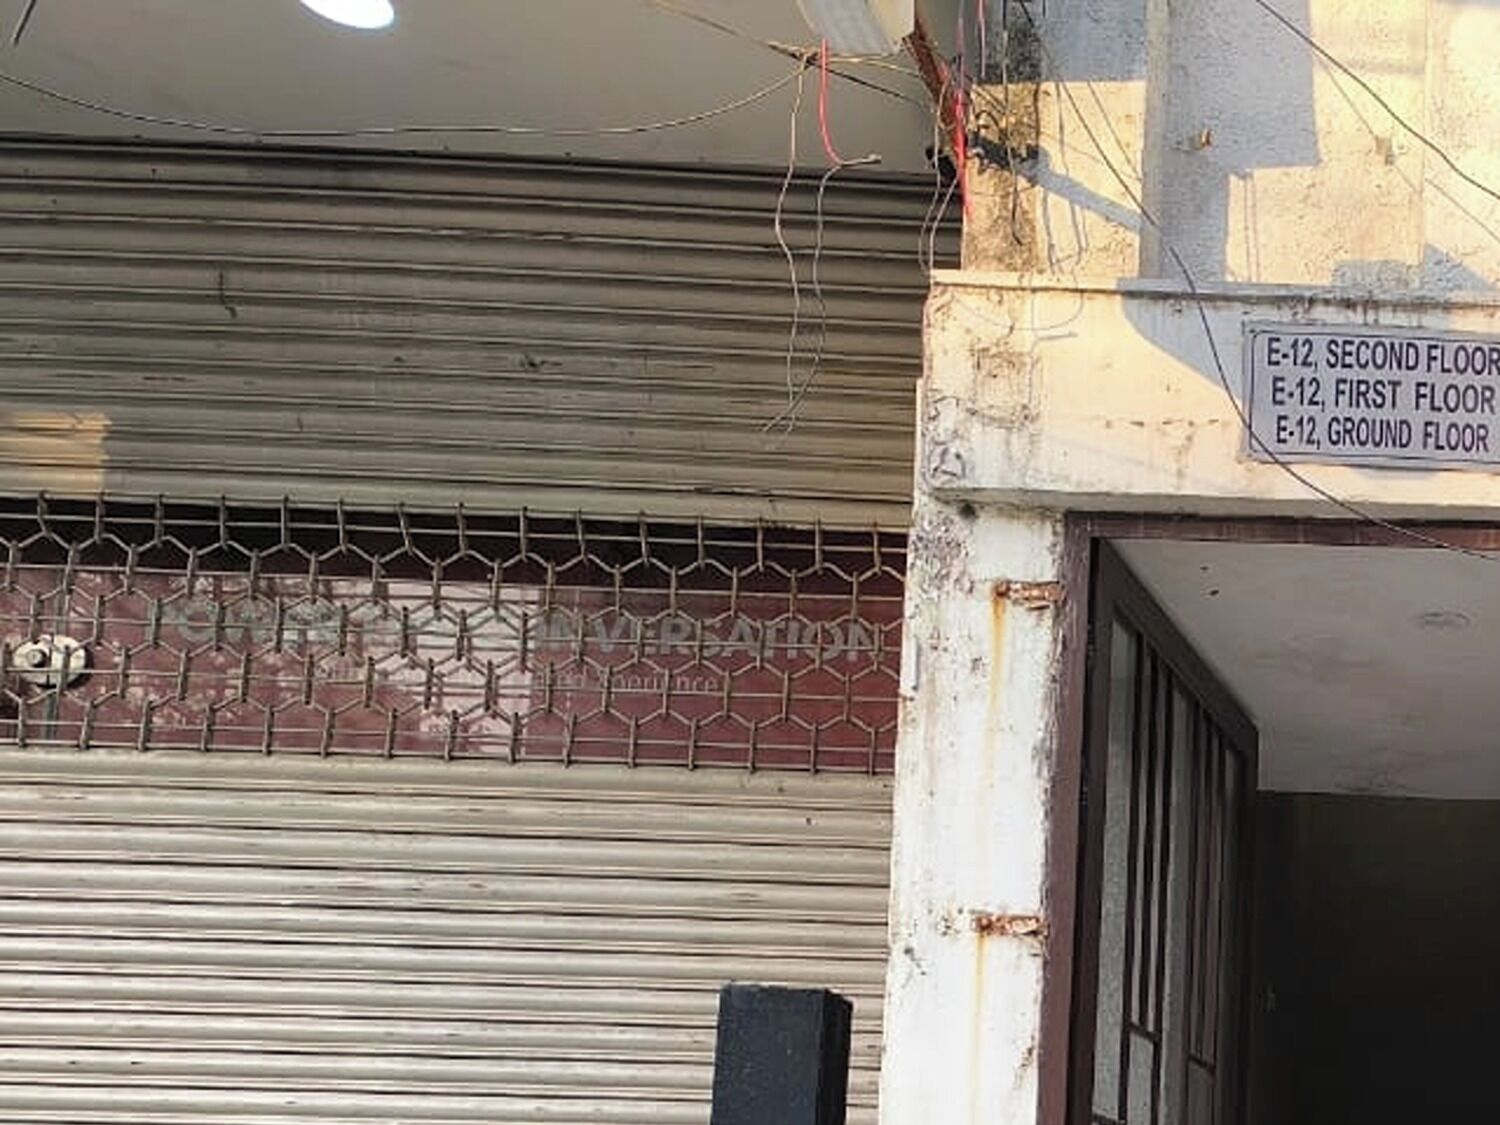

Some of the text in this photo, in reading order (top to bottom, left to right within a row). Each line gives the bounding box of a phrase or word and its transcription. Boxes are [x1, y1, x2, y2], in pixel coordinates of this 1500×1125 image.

[1266, 336, 1319, 371] E-12,
[1326, 339, 1419, 372] SECOND
[1272, 375, 1496, 415] E-12, FIRST FLOOR
[1276, 415, 1489, 453] E-12, GROUND FLOOR
